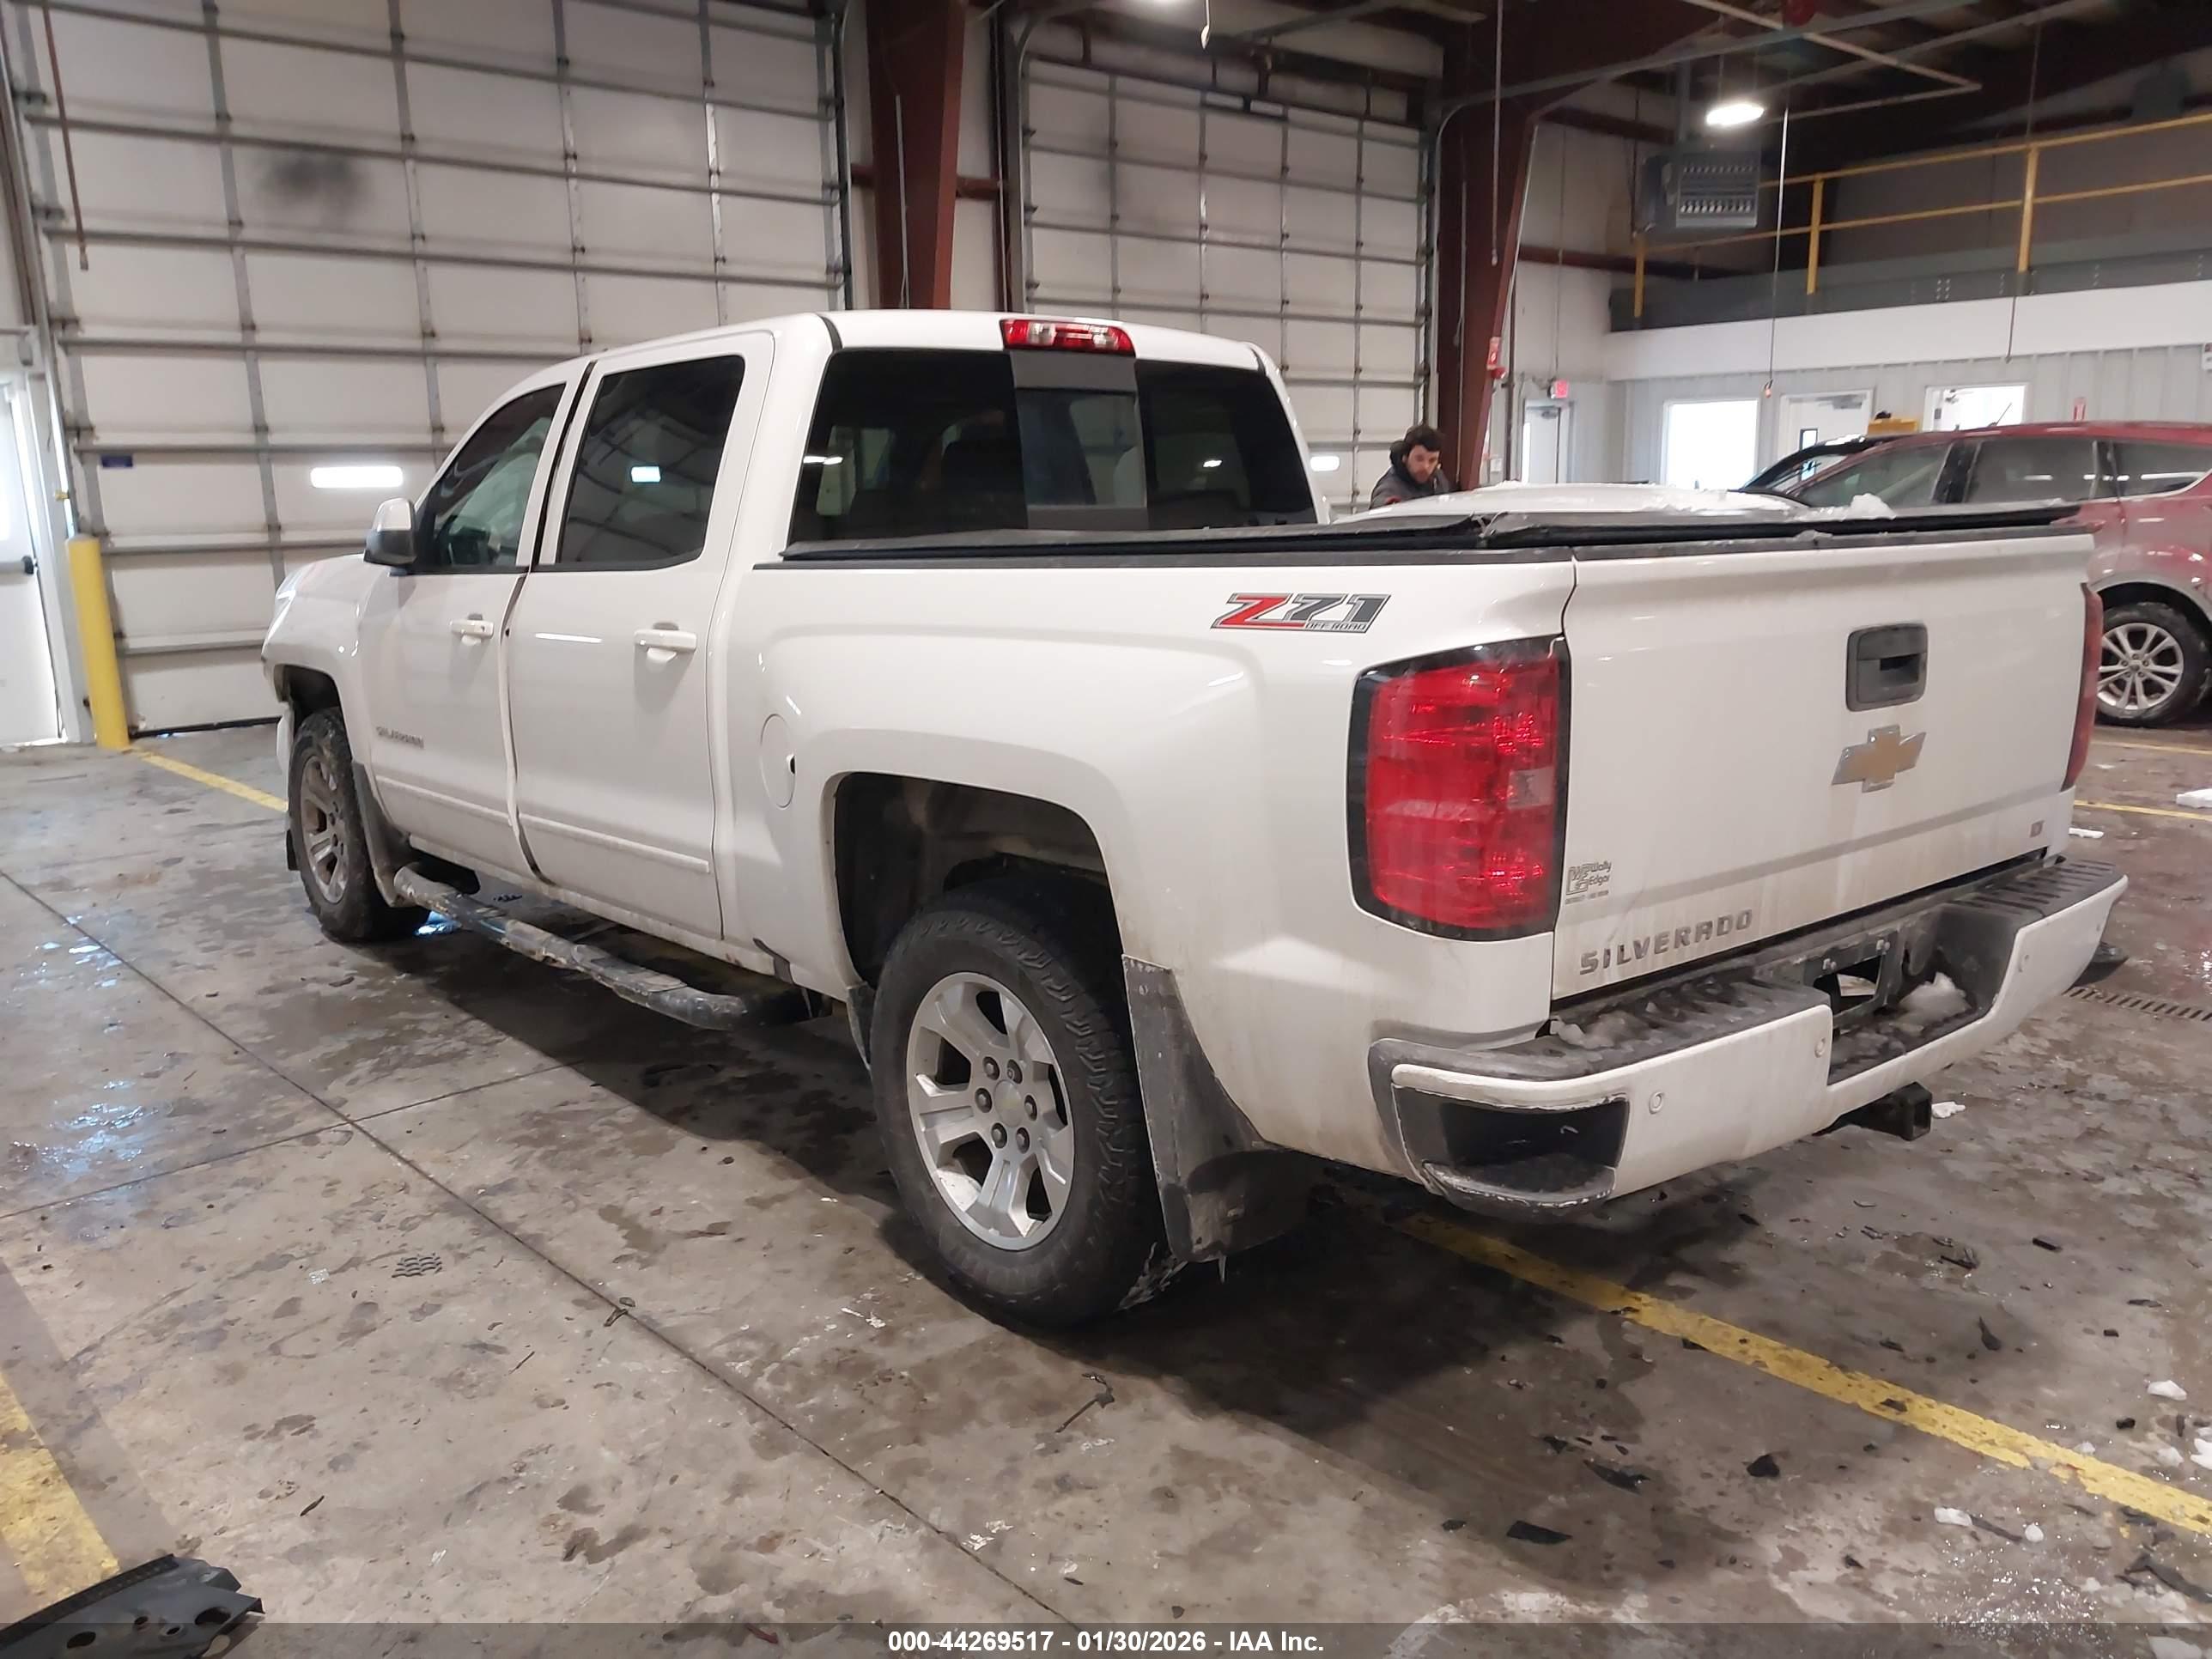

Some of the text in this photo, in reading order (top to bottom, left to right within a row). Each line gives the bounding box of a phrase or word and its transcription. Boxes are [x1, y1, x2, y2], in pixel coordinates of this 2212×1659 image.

[1210, 592, 1391, 633] Z71
[1589, 874, 1611, 886] Edgar
[1579, 908, 1753, 975] SILVERADO
